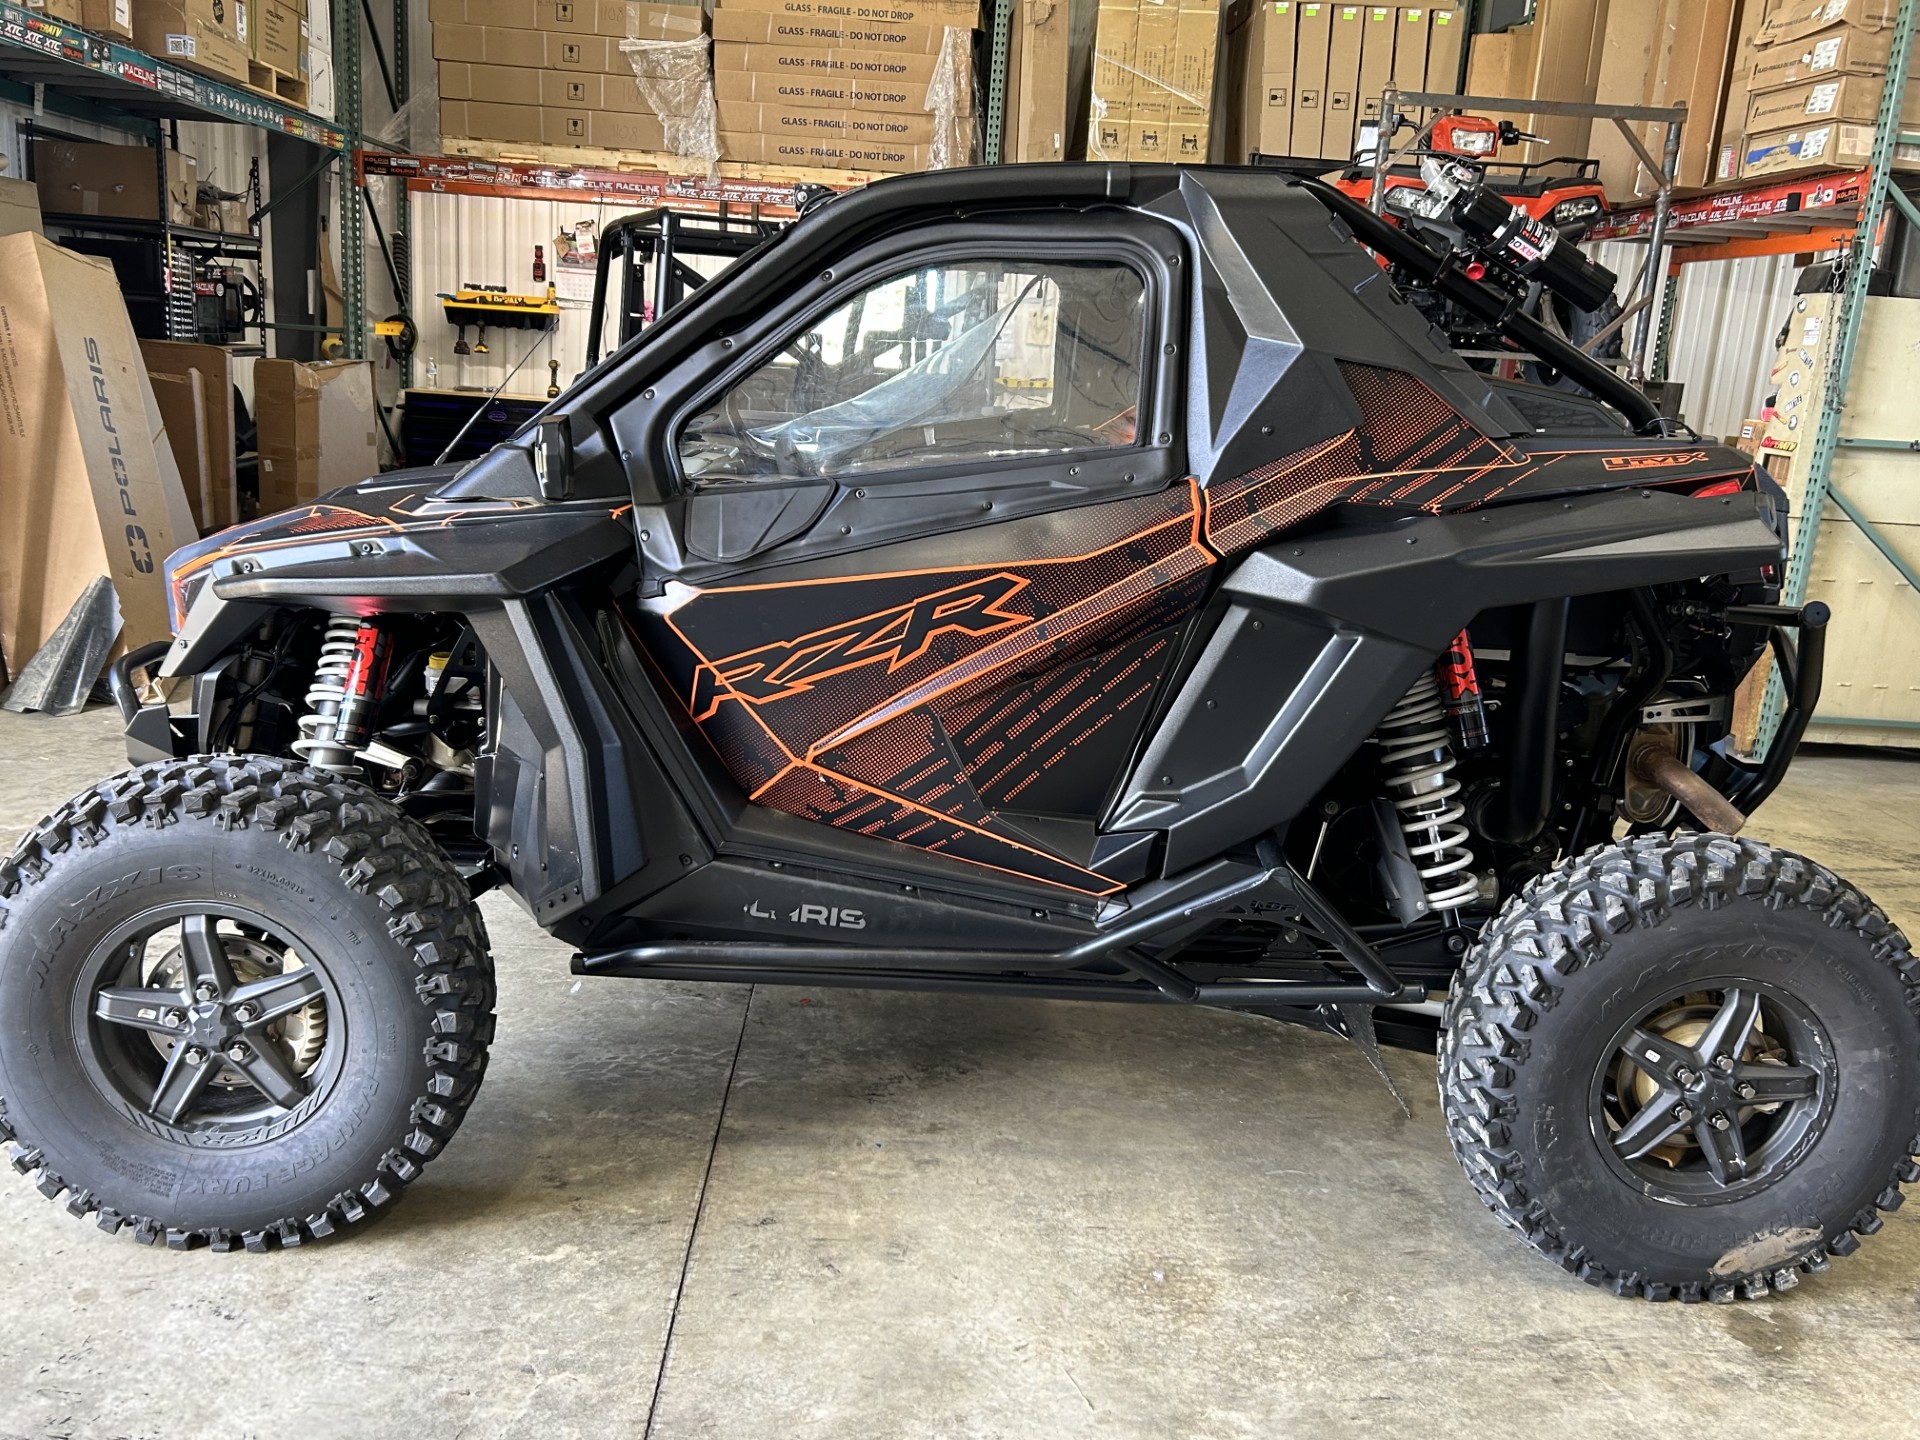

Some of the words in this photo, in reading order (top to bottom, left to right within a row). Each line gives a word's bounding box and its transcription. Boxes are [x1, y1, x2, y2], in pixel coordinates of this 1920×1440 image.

[785, 3, 811, 12] GLASS
[818, 6, 851, 15] FRAGILE
[858, 9, 870, 17] DO
[872, 10, 889, 18] NOT
[891, 11, 914, 20] DROP
[5, 23, 24, 36] XTC
[25, 30, 44, 44] XTC
[45, 38, 62, 51] XTC
[778, 27, 804, 35] GLASS
[810, 29, 844, 38] FRAGILE
[864, 33, 881, 41] NOT
[883, 34, 907, 42] DROP
[124, 63, 156, 83] RACELINE
[779, 58, 805, 66] GLASS
[811, 60, 844, 69] FRAGILE
[865, 63, 881, 72] NOT
[884, 65, 907, 73] DROP
[779, 87, 805, 95] GLASS
[811, 89, 844, 98] FRAGILE
[850, 91, 863, 99] DO
[864, 93, 881, 101] NOT
[885, 94, 906, 102] DROP
[782, 117, 807, 126] GLASS
[814, 120, 847, 129] FRAGILE
[853, 122, 866, 130] DO
[867, 123, 884, 131] NOT
[886, 124, 908, 132] DROP
[779, 146, 805, 154] GLASS
[811, 148, 844, 157] FRAGILE
[864, 152, 881, 160] NOT
[883, 153, 905, 161] DROP
[522, 175, 566, 186] RACELINE
[615, 182, 660, 194] RACELINE
[639, 196, 657, 204] XTC
[680, 188, 699, 196] XTC
[721, 191, 741, 199] XTC
[742, 192, 762, 200] XTC
[1712, 194, 1743, 207] RACELINE
[1741, 201, 1773, 213] RACELINE
[1680, 211, 1707, 222] RACELINE
[83, 336, 137, 516] POLARIS
[689, 571, 1035, 724] RZR
[743, 899, 866, 930] LRIS
[26, 864, 202, 989] MAXXIS
[1601, 943, 1797, 1021] MAXXIS
